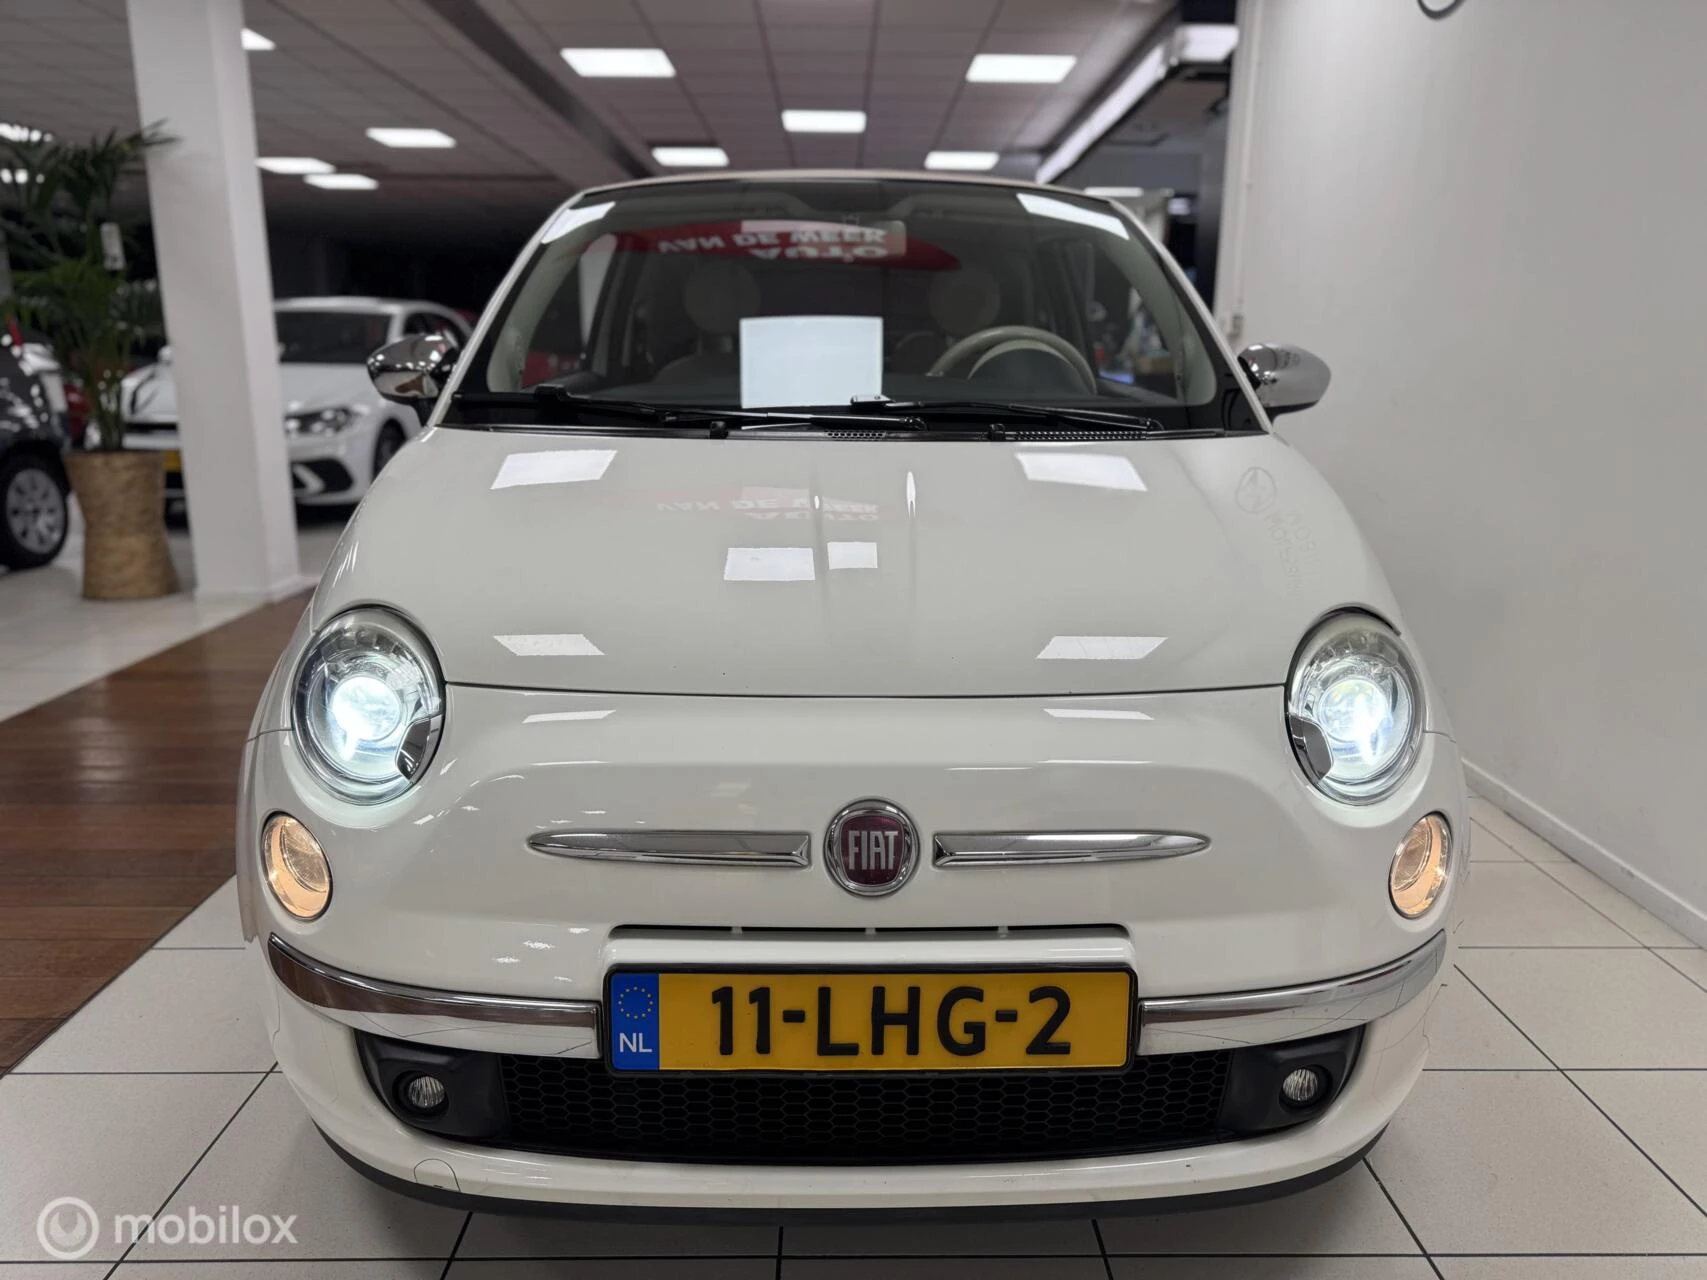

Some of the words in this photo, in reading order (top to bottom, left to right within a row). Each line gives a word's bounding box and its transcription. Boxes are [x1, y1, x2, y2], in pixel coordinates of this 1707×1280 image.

[848, 830, 899, 870] FIAT
[711, 986, 1072, 1057] 11-LHG-2
[619, 1032, 653, 1053] NL
